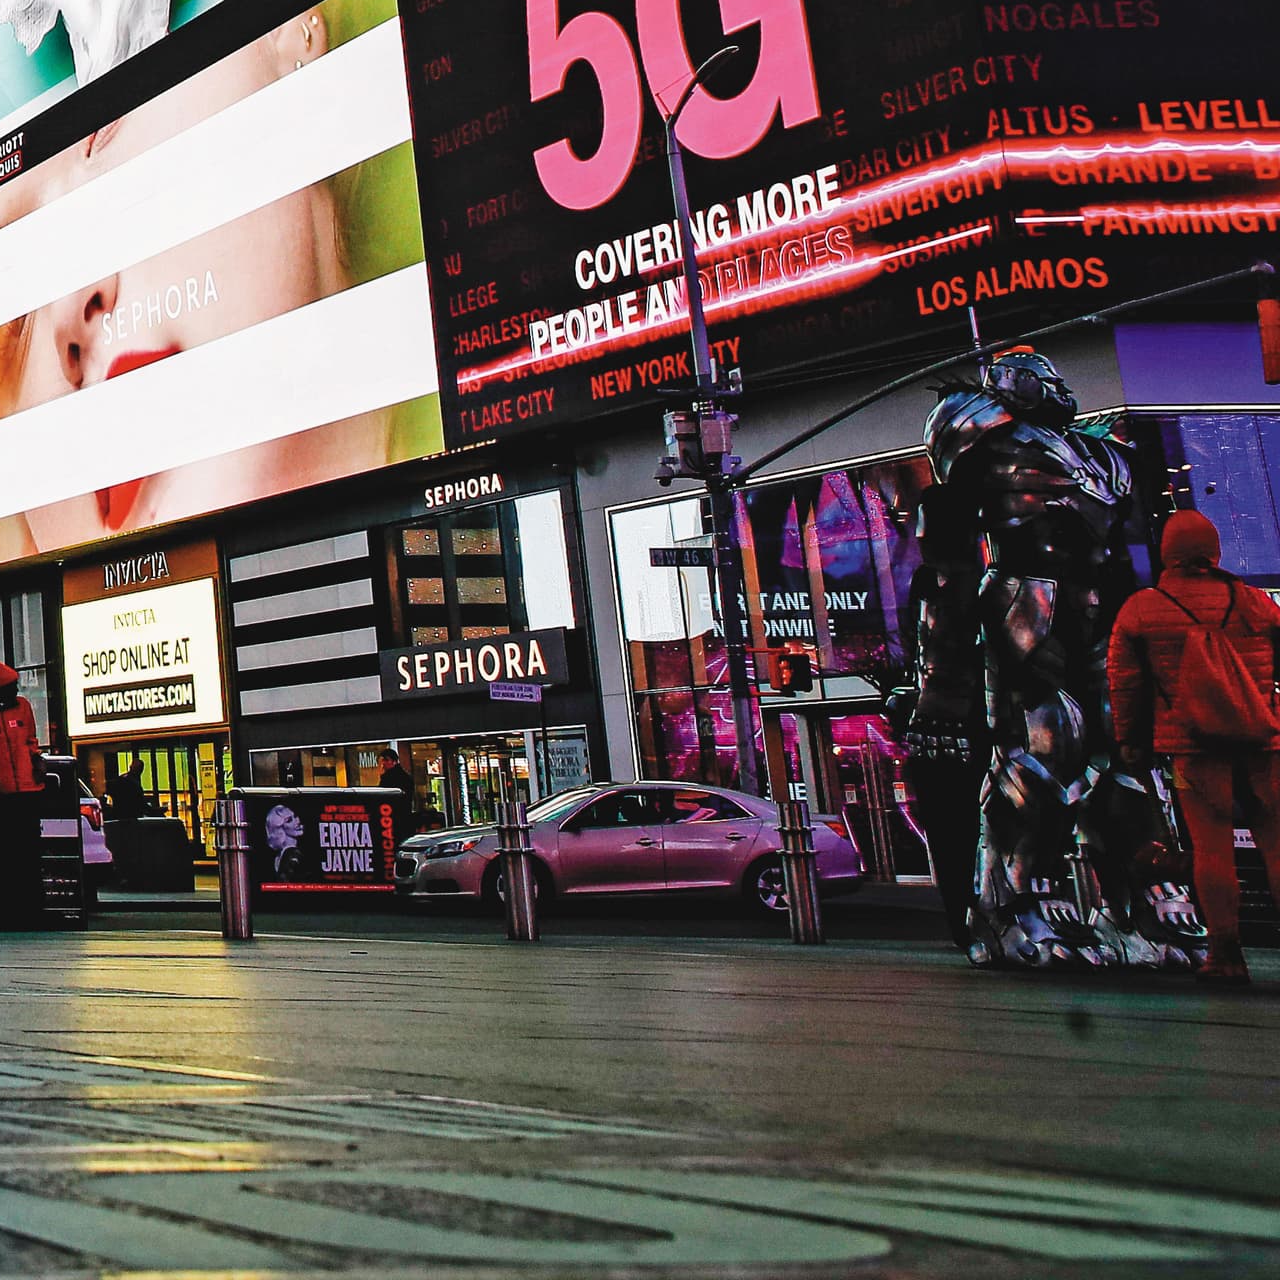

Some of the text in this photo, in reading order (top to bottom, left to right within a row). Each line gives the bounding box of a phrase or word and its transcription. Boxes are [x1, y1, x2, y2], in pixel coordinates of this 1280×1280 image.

[984, 0, 1161, 33] NOGALES
[880, 53, 1043, 120] SILVER CITY
[987, 103, 1095, 139] ALTUS
[575, 164, 840, 291] COVERING MORE
[917, 257, 1109, 316] LOS ALAMOS
[101, 270, 219, 346] SEPHORA
[529, 288, 638, 360] PEOPLE
[591, 352, 691, 400] NEW YORK
[473, 388, 555, 432] LAKE CITY
[424, 473, 502, 508] SEPHORA
[103, 551, 170, 590] INVICTA
[666, 549, 700, 564] W 46
[113, 608, 157, 630] INVICTA
[82, 637, 190, 678] SHOP ONLINE AT
[398, 639, 547, 691] SEPHORA
[85, 683, 193, 717] INVICTASTORES.COM
[358, 752, 378, 768] Milk
[318, 822, 373, 848] ERIKA
[321, 849, 374, 872] JAYNE
